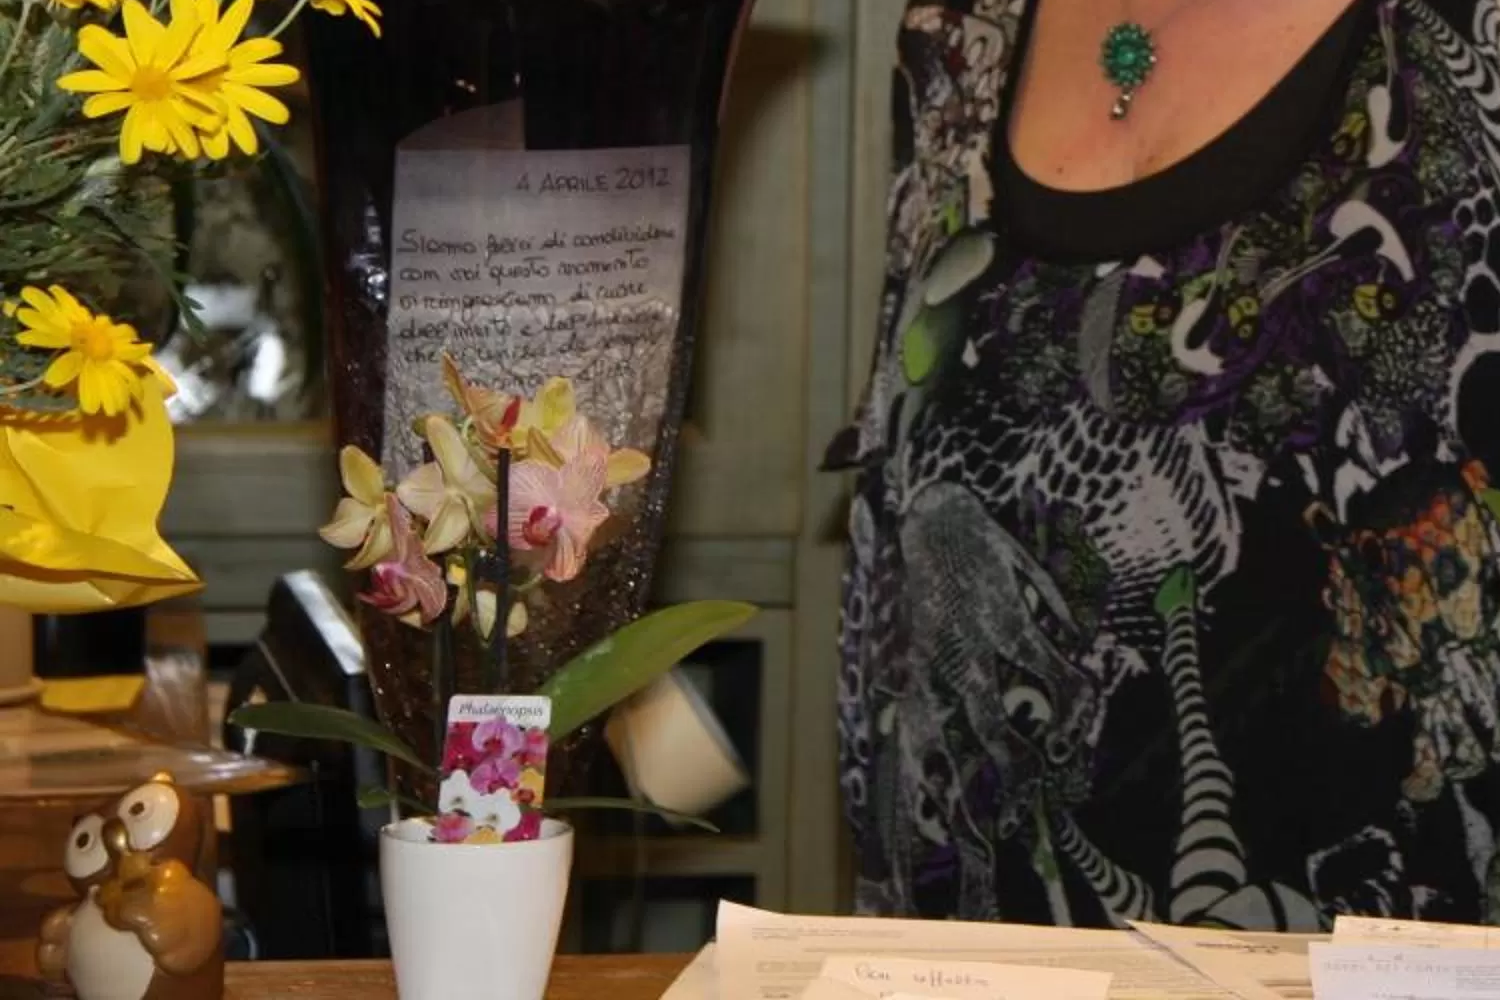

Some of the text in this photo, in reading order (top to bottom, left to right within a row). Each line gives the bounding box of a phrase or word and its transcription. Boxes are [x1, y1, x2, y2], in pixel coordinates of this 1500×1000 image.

[539, 172, 609, 194] APRILE
[614, 166, 672, 190] 2012
[396, 228, 478, 257] Siamo
[399, 266, 441, 282] con
[489, 256, 550, 287] questo
